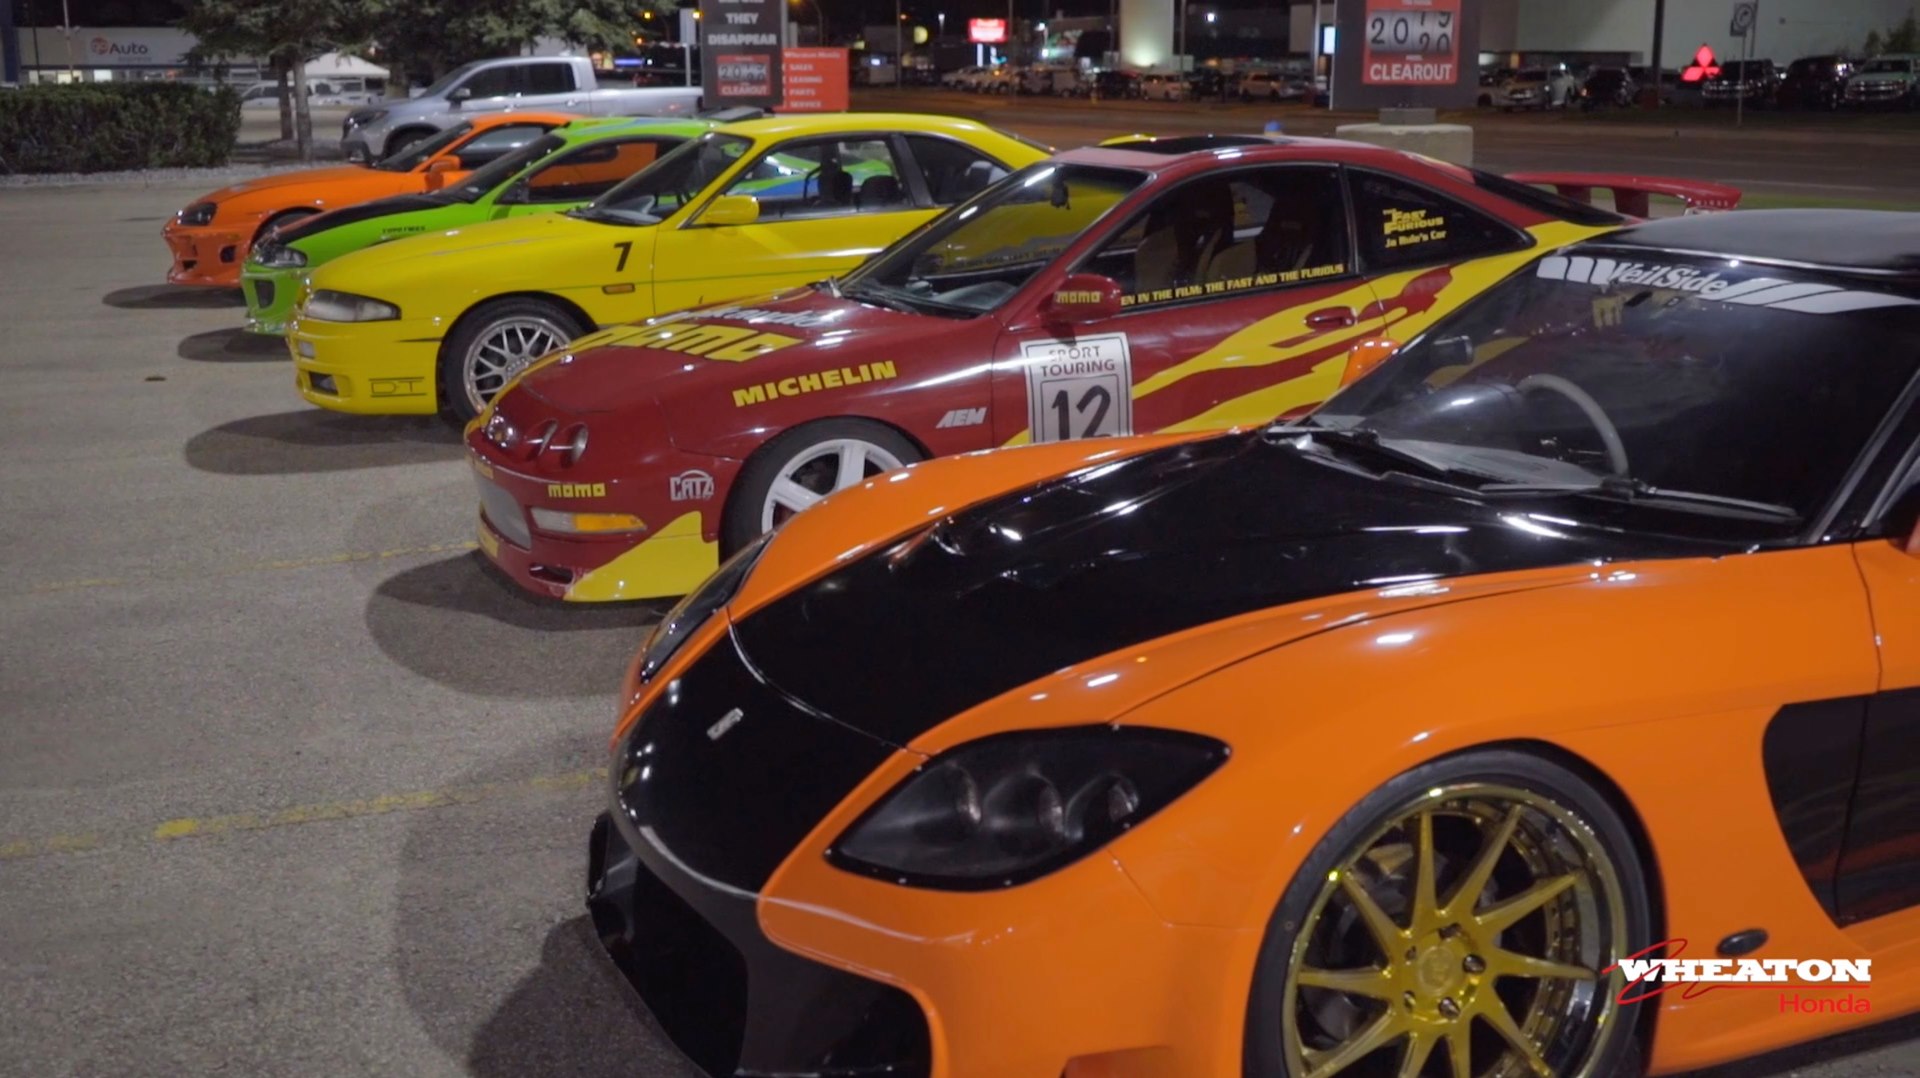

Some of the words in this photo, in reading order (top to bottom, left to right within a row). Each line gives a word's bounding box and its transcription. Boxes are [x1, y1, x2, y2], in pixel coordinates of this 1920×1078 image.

[725, 13, 759, 24] THEY
[708, 34, 777, 45] DISAPPEAR
[108, 43, 149, 55] Auto
[1369, 63, 1452, 81] CLEAROUT
[721, 85, 768, 95] CLEAROUT
[1430, 230, 1448, 241] Car
[1120, 295, 1135, 306] EN
[1137, 293, 1151, 304] IN
[1153, 288, 1174, 301] THE
[1204, 280, 1226, 294] THE
[1227, 276, 1253, 290] FAST
[1255, 273, 1278, 286] AND
[1279, 269, 1300, 282] THE
[1301, 263, 1345, 280] FURIOUS
[1056, 290, 1101, 304] momo
[1049, 345, 1101, 361] SPORT
[1041, 359, 1116, 378] TOURING
[732, 360, 897, 408] MICHELIN
[935, 407, 988, 429] AEM
[1051, 385, 1112, 441] 12
[547, 483, 606, 498] momo
